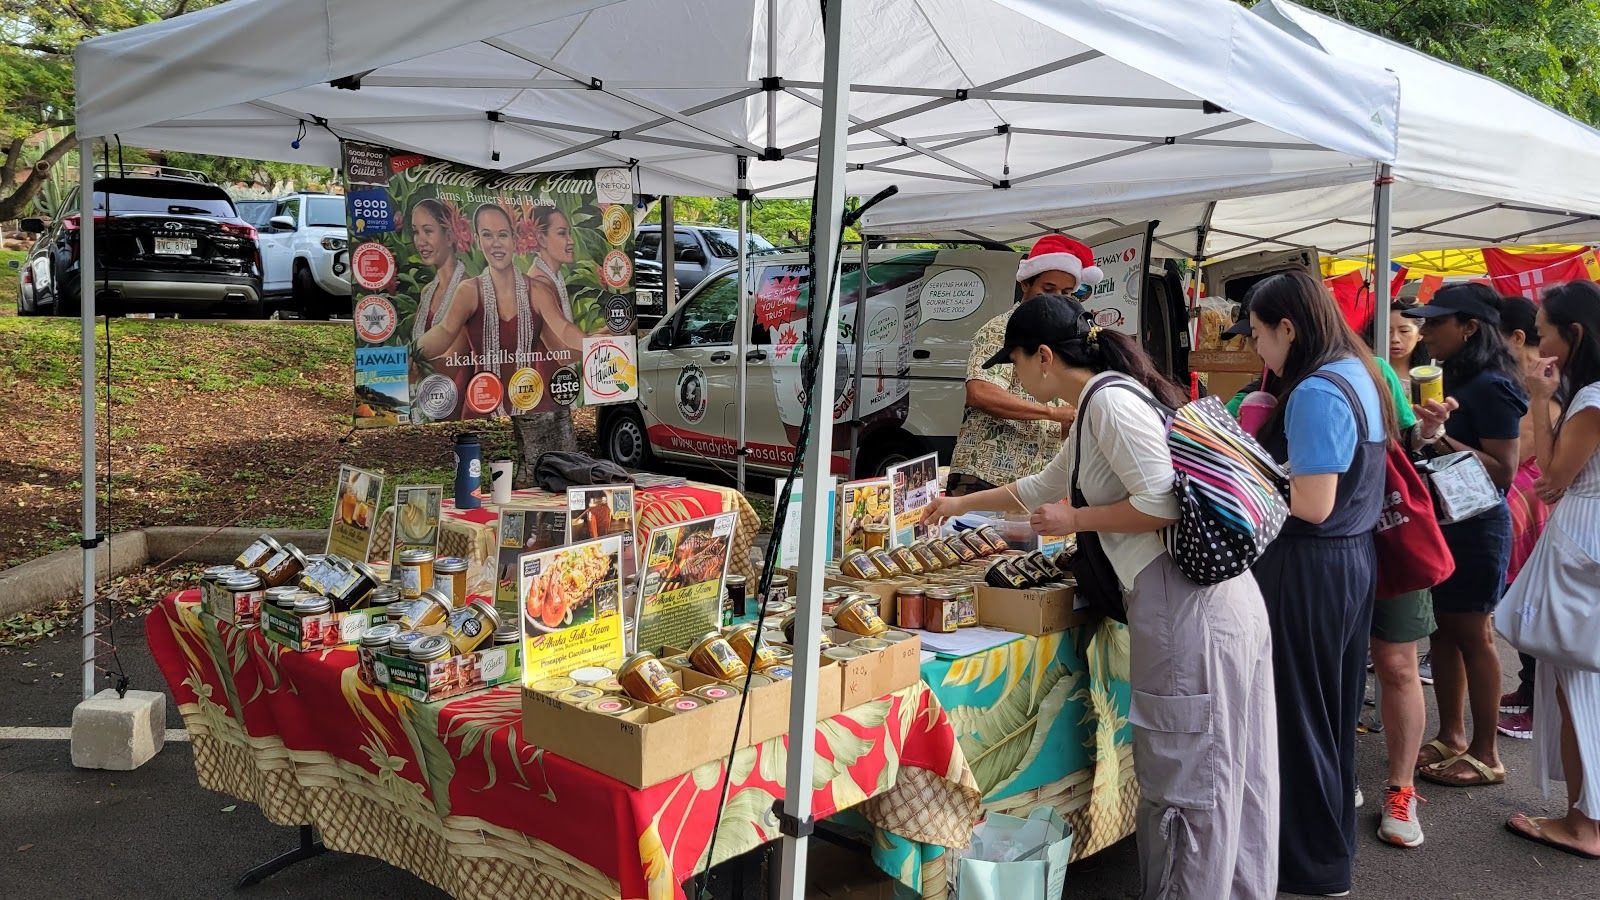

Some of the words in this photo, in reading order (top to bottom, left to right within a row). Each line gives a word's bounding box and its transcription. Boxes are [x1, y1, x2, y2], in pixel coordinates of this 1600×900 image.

[350, 156, 383, 168] Merchants
[366, 151, 383, 159] FOOD
[350, 164, 377, 177] Guild
[405, 161, 485, 188] Akaka
[541, 170, 596, 195] Farm
[354, 199, 388, 209] GOOD
[435, 188, 464, 203] Jams,
[467, 191, 501, 205] Butters
[504, 193, 522, 207] and
[525, 195, 557, 210] Honey
[354, 208, 388, 219] FOOD
[760, 293, 771, 302] THE
[774, 284, 797, 298] SALSA
[929, 290, 951, 298] FRESH
[953, 290, 975, 298] LOCAL
[761, 302, 776, 311] YOU
[777, 296, 793, 306] CAN
[611, 309, 625, 317] ITA
[765, 307, 787, 321] TRUST
[869, 319, 897, 337] CILANTRO
[445, 349, 571, 367] akakafallsfarm.com
[557, 374, 572, 384] great
[518, 384, 535, 394] ITA
[550, 381, 580, 394] taste
[430, 392, 445, 400] ITA
[870, 391, 891, 406] MEDIUM
[590, 623, 610, 637] Farm
[540, 655, 567, 668] Pineapple
[568, 648, 592, 659] Carolina
[592, 642, 611, 652] Reaper
[484, 656, 503, 672] Ball
[390, 667, 406, 677] MASON
[406, 670, 418, 681] JARS
